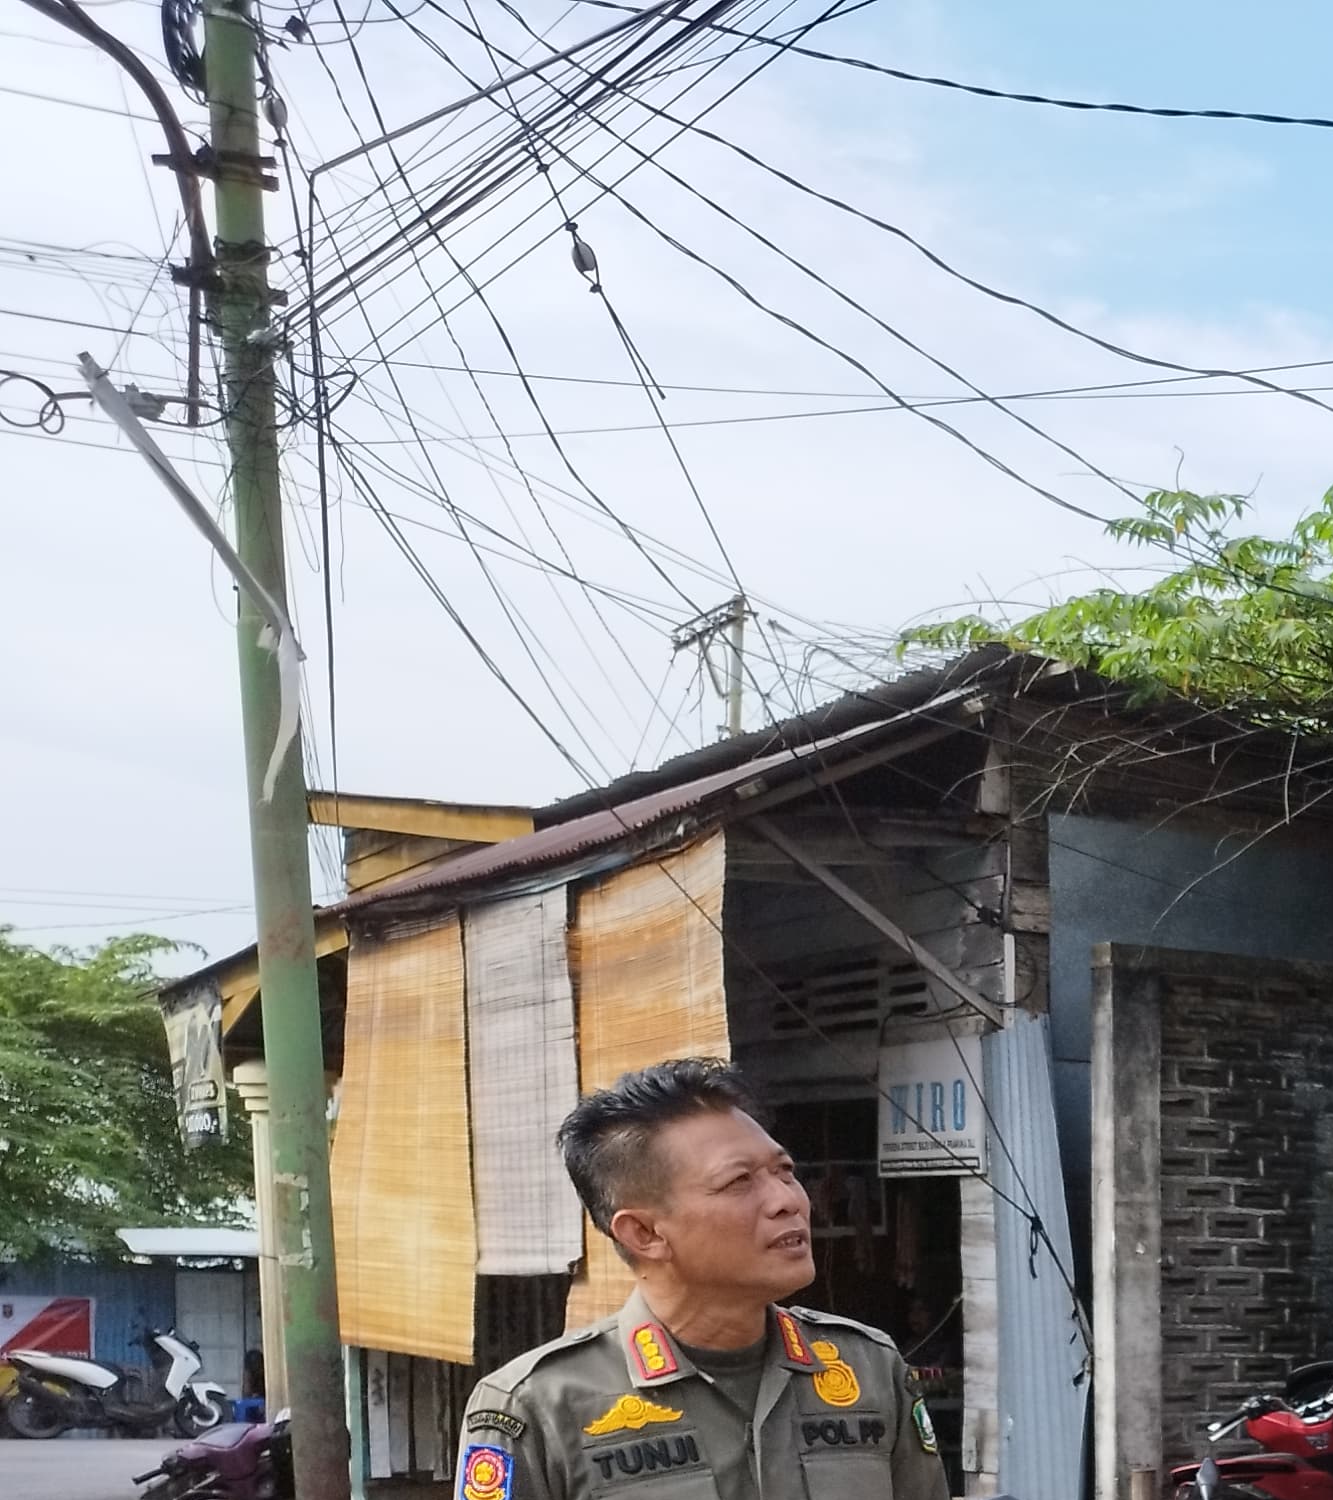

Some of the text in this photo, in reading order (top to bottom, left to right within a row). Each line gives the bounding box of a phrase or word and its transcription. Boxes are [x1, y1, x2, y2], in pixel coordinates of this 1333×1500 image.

[889, 1079, 966, 1135] WIRO
[802, 1418, 886, 1446] POL PP
[593, 1434, 700, 1480] TUNJI
